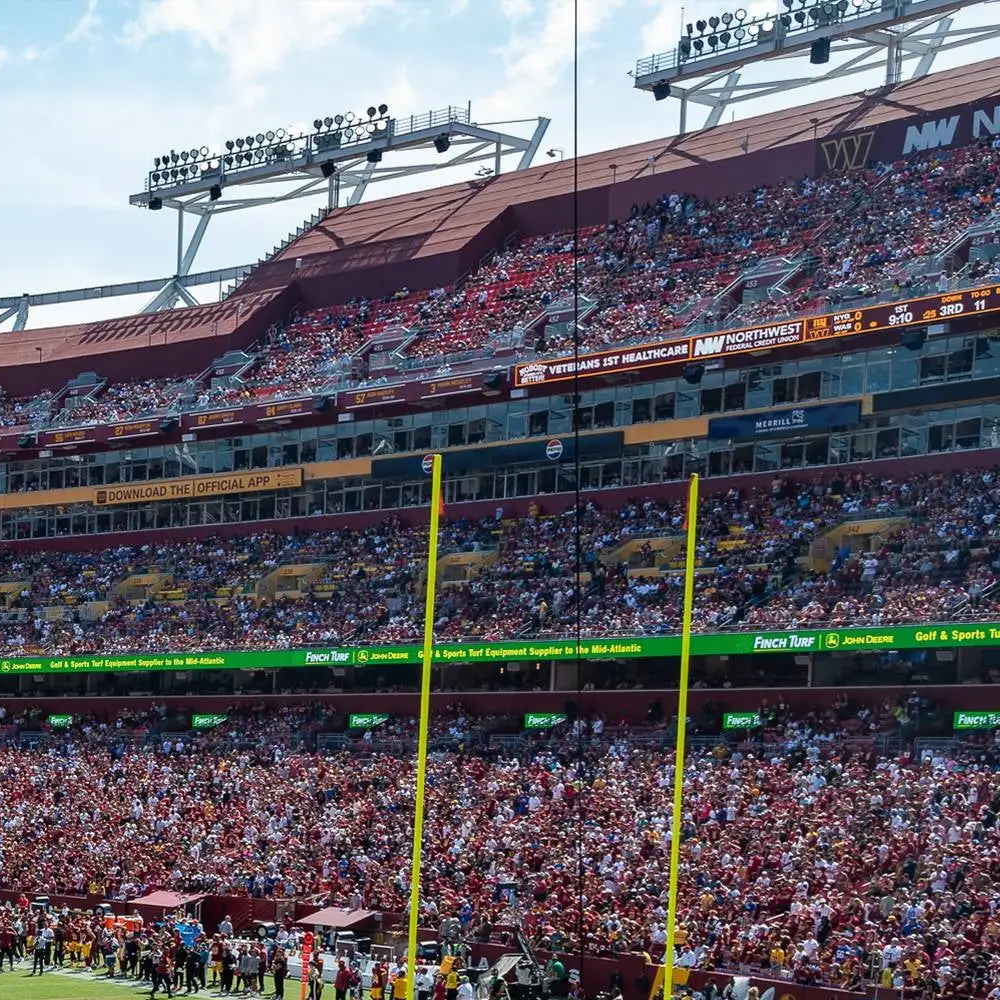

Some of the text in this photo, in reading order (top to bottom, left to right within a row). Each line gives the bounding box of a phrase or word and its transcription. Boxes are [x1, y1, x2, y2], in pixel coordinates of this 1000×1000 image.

[942, 295, 962, 303] DOWN
[981, 289, 990, 297] GO
[895, 304, 908, 313] 1ST
[939, 300, 986, 316] 3RD 11
[854, 312, 862, 320] 0
[888, 312, 913, 325] 9:10
[834, 322, 862, 331] WAS 0
[694, 322, 802, 356] NW NORTHWEST
[726, 334, 800, 351] FEDERAL CREDIT UNION
[550, 344, 688, 375] VETERANS 1ST HEALTHCARE
[355, 393, 366, 404] 57
[755, 418, 791, 429] MERRILL
[108, 486, 166, 501] DOWNLOAD
[170, 483, 190, 495] THE
[197, 478, 243, 493] OFFICIAL
[248, 475, 270, 487] APP
[754, 635, 787, 648] FINCH
[788, 634, 815, 648] TURF
[842, 636, 865, 645] JOHN
[866, 635, 894, 644] DEERE
[915, 631, 937, 641] Golf
[940, 631, 948, 640] &
[952, 629, 985, 640] Sports
[306, 651, 330, 662] FINCH
[330, 650, 349, 662] TURF
[370, 652, 387, 660] JOHN
[388, 651, 408, 660] DEERE
[442, 650, 466, 659] Sports
[469, 648, 483, 657] Turf
[485, 647, 527, 657] Equipment
[529, 646, 563, 656] Supplier
[565, 646, 573, 654] to
[576, 645, 590, 654] the
[591, 643, 641, 653] Mid-Atlantic
[70, 660, 90, 669] Sports
[105, 659, 137, 668] Equipment
[138, 659, 164, 667] Supplier
[173, 657, 184, 665] the
[186, 656, 224, 665] Mid-Atlantic
[727, 715, 751, 725] FINCH
[958, 714, 986, 725] FINCH
